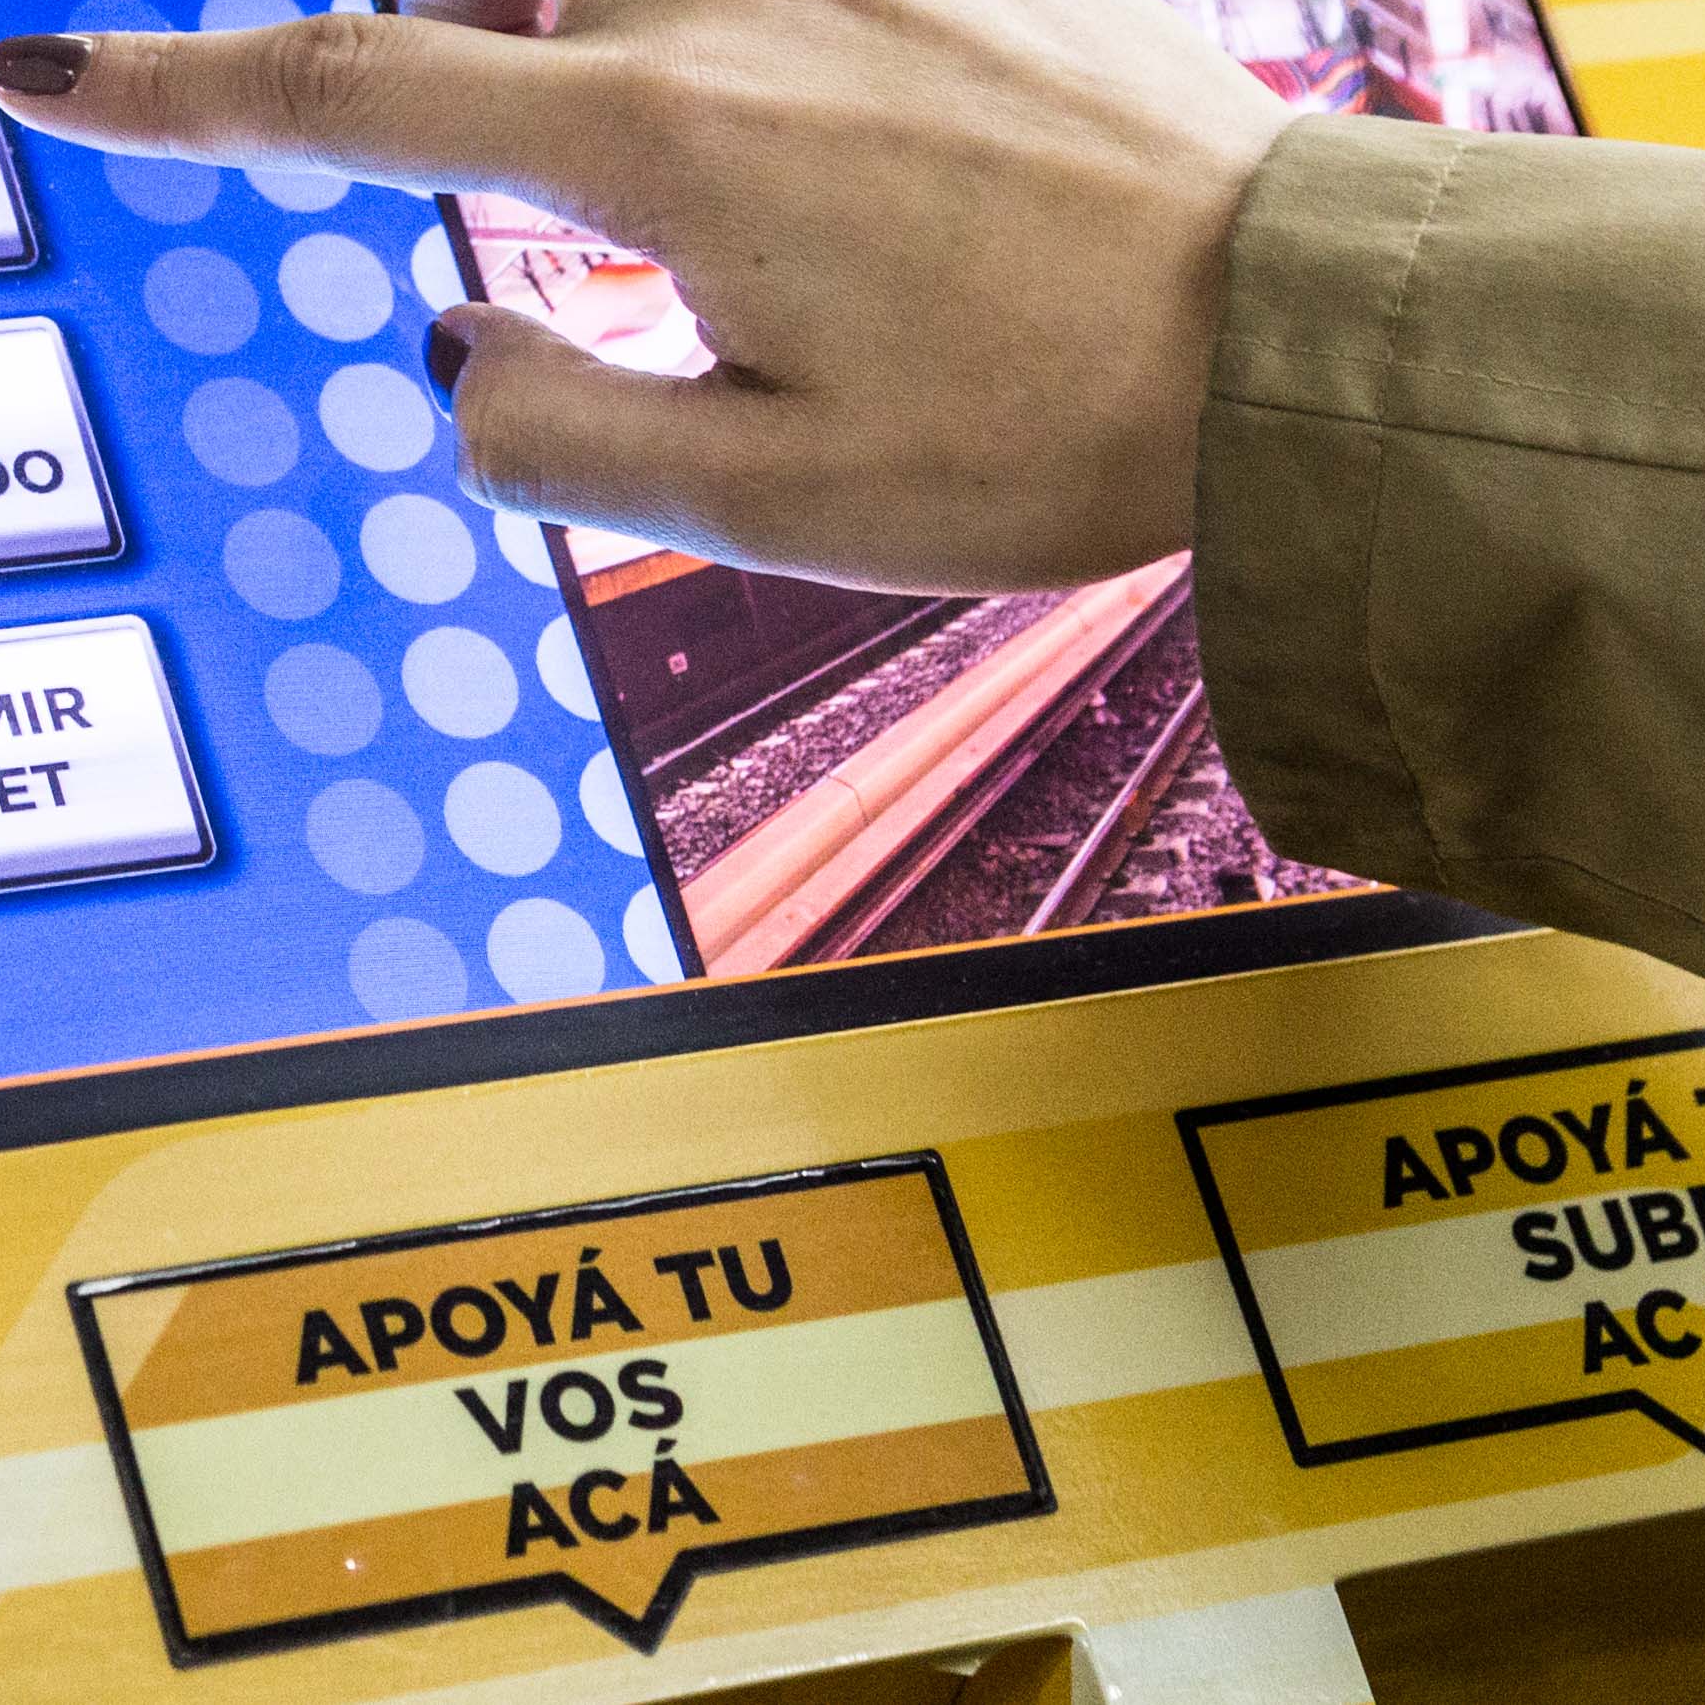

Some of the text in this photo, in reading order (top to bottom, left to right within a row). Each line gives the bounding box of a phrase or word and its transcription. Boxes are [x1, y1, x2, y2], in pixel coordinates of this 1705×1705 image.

[1381, 1078, 1687, 1209] APOYÁ
[294, 1237, 795, 1385] APOYÁ TU
[452, 1357, 684, 1455] VOS
[503, 1440, 721, 1560] ACÁ
